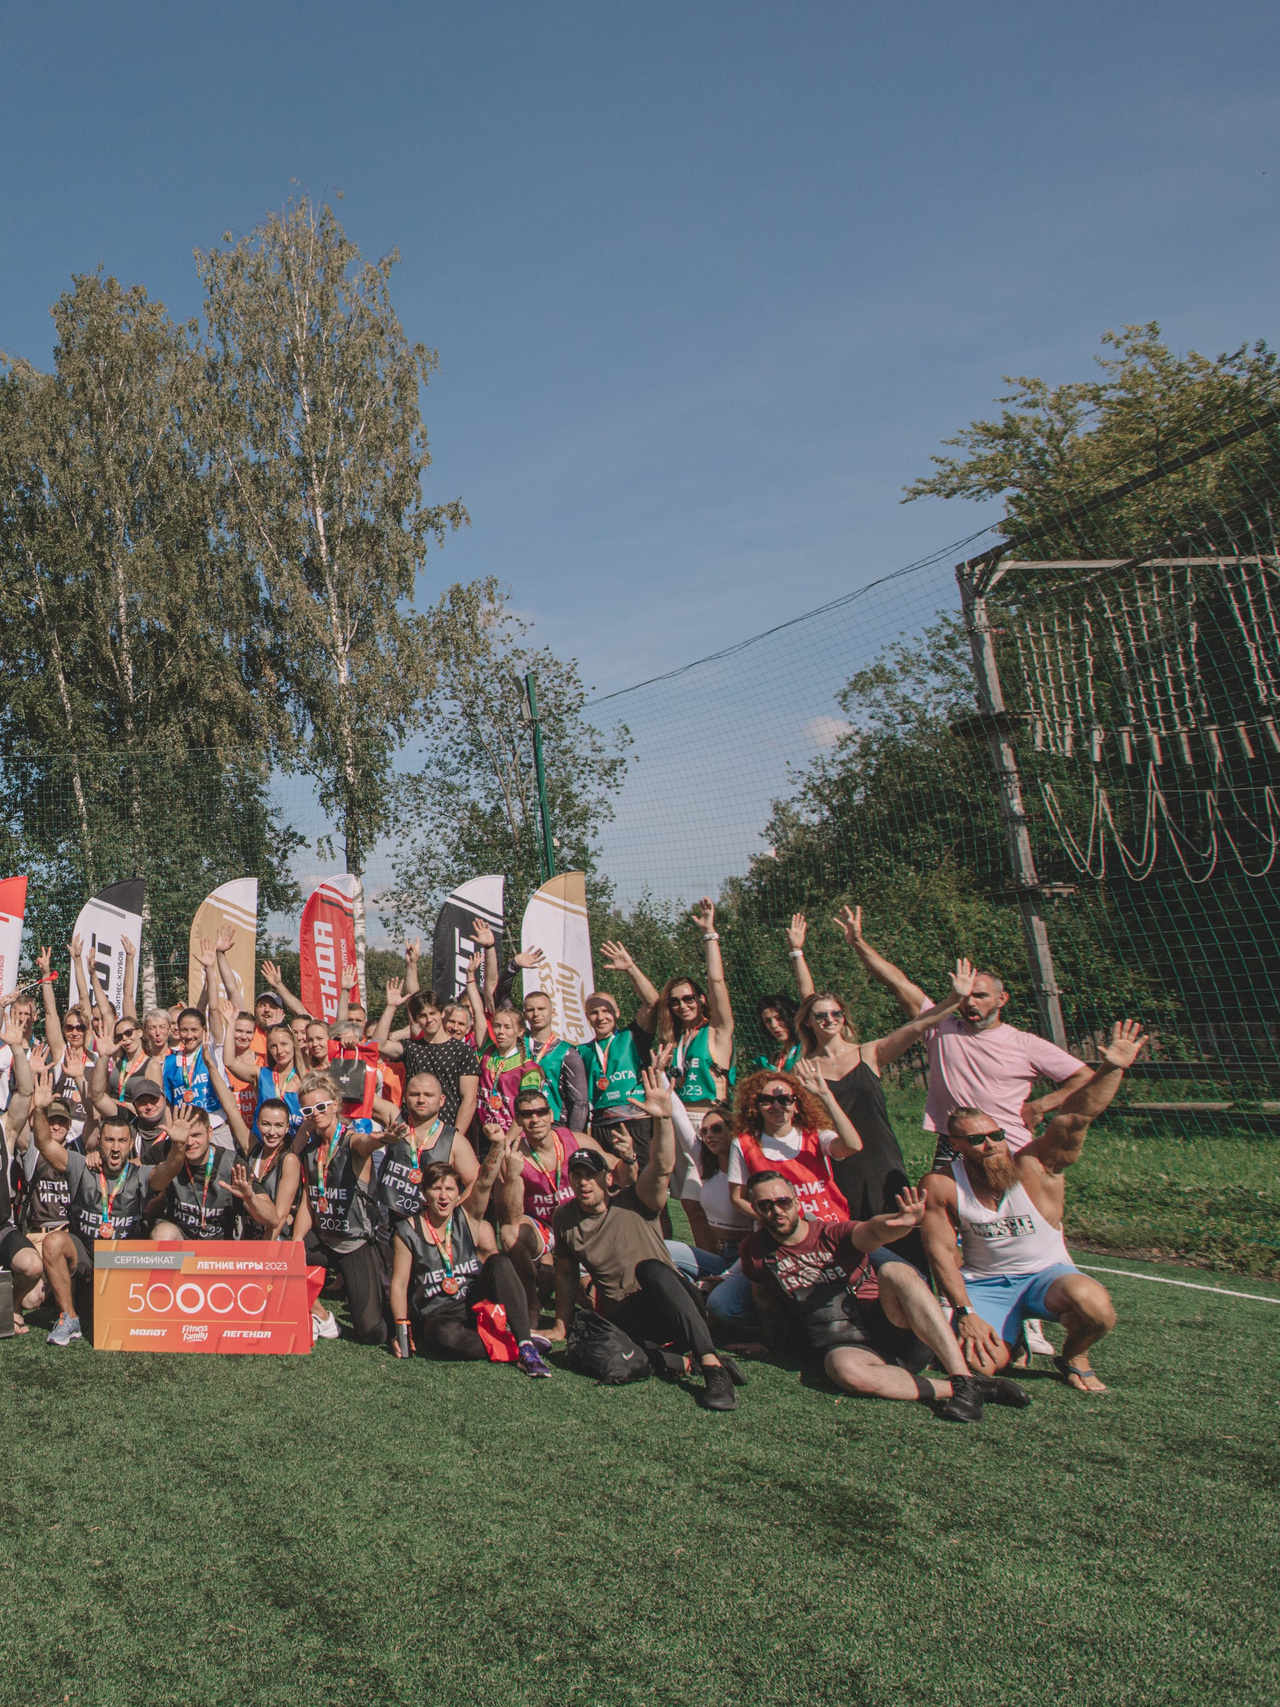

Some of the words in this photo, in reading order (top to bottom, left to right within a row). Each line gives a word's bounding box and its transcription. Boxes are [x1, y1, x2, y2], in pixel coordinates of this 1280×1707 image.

[381, 1174, 417, 1196] ИГРЫ
[320, 1217, 350, 1232] 2023
[114, 1256, 175, 1265] СЕРТИФИКАТ
[196, 1261, 236, 1271] ЛЕТНИЕ
[236, 1262, 264, 1270] ИГРЫ
[265, 1261, 288, 1271] 2023
[129, 1328, 168, 1337] МОЛОТ
[182, 1324, 209, 1335] Fitness
[222, 1330, 272, 1338] ЛЕГЕНДА
[183, 1332, 209, 1341] Family
